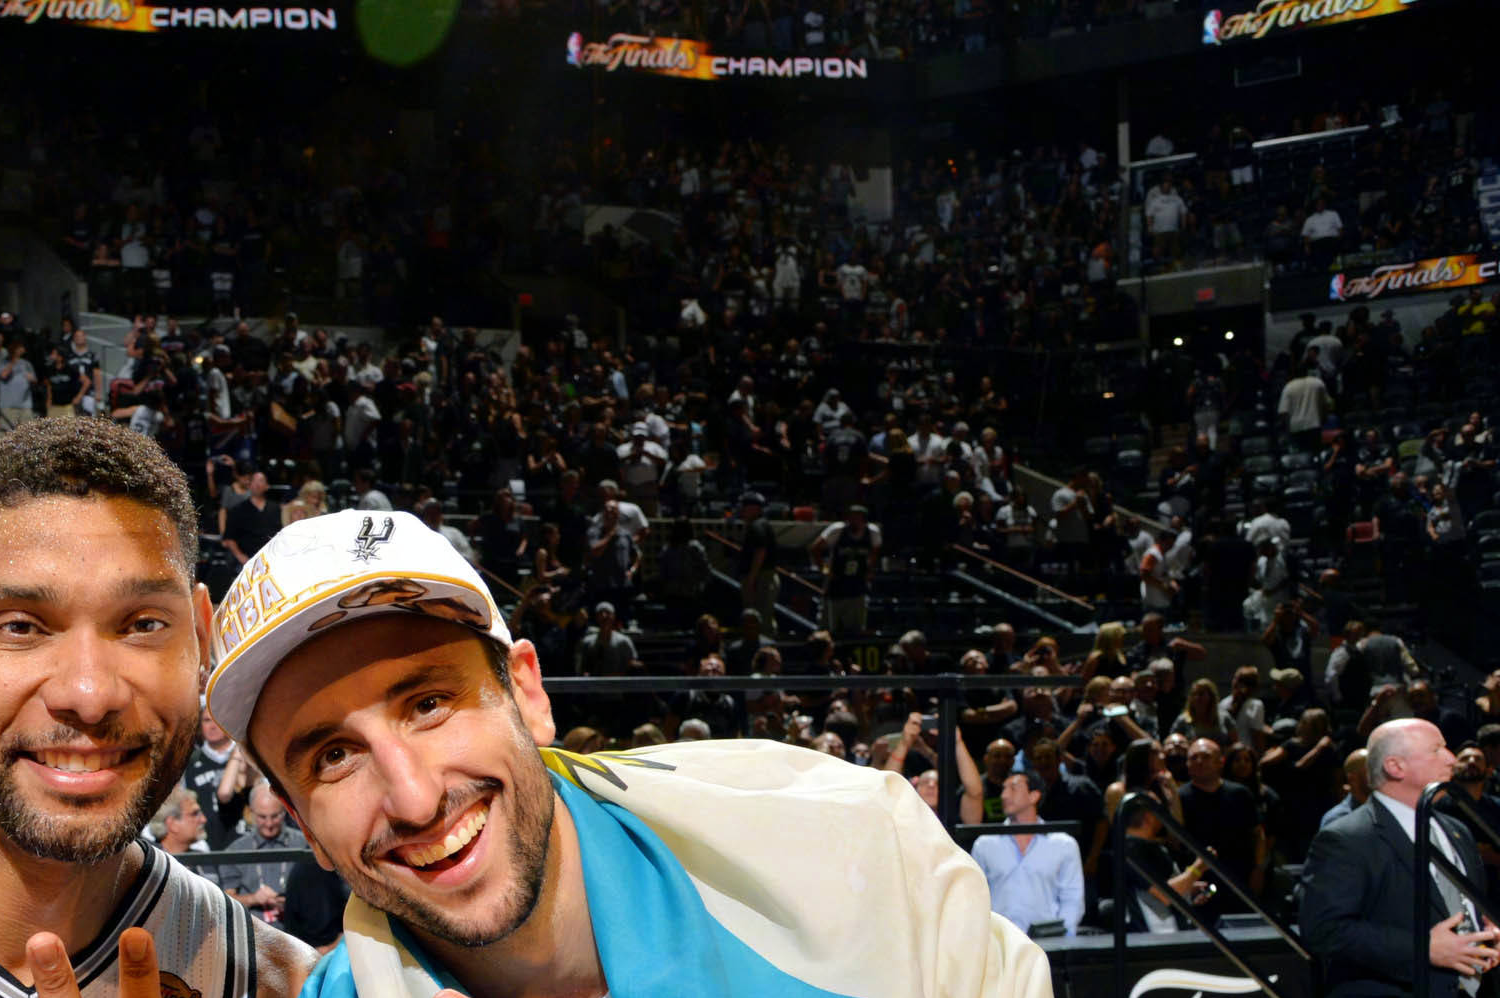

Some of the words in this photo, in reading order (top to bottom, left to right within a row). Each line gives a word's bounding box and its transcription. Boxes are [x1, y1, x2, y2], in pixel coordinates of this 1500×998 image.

[150, 8, 337, 30] CHAMPION
[604, 33, 697, 71] Finals
[711, 57, 868, 78] CHAMPION
[1367, 257, 1465, 299] Finals
[1478, 262, 1500, 277] C
[221, 577, 286, 655] NBA
